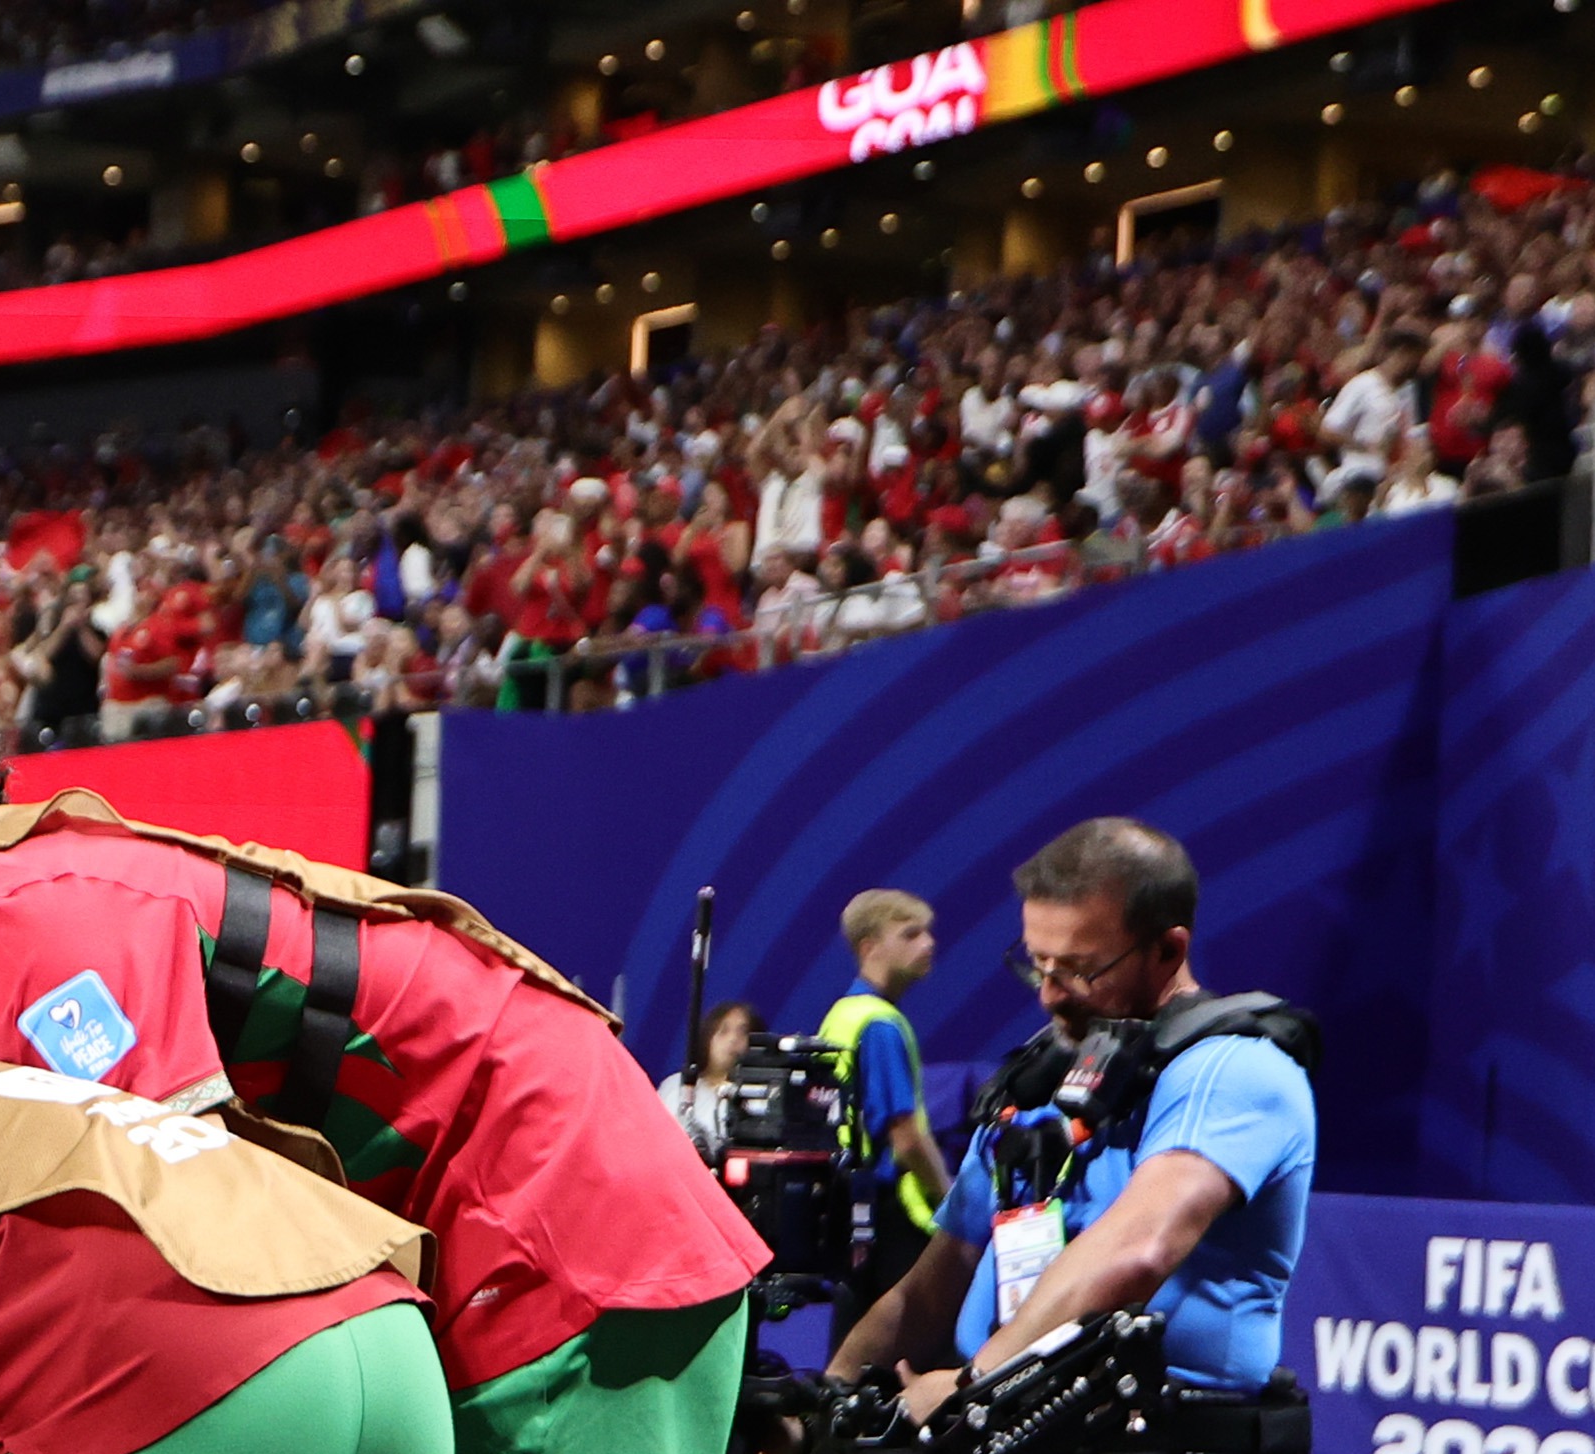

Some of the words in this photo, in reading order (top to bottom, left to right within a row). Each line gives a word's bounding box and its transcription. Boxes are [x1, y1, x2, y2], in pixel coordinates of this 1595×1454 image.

[71, 1033, 116, 1070] PEACE
[1424, 1235, 1565, 1322] FIFA
[1313, 1316, 1541, 1411] WORLD
[1545, 1336, 1595, 1417] C
